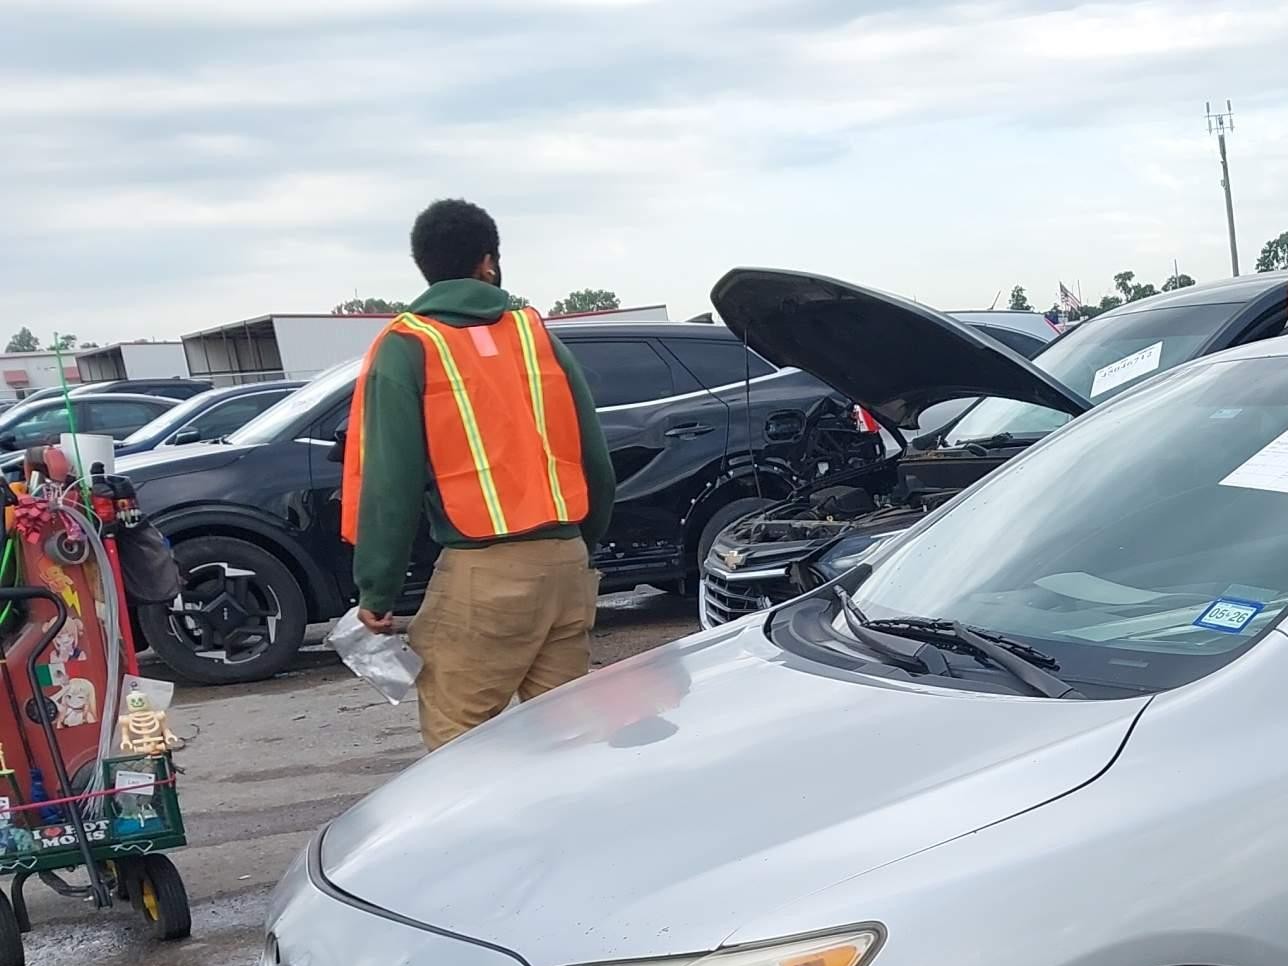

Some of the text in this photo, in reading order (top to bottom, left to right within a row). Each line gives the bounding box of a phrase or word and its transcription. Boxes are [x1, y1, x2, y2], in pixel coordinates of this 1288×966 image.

[1208, 607, 1249, 623] 05 26
[33, 829, 42, 840] I
